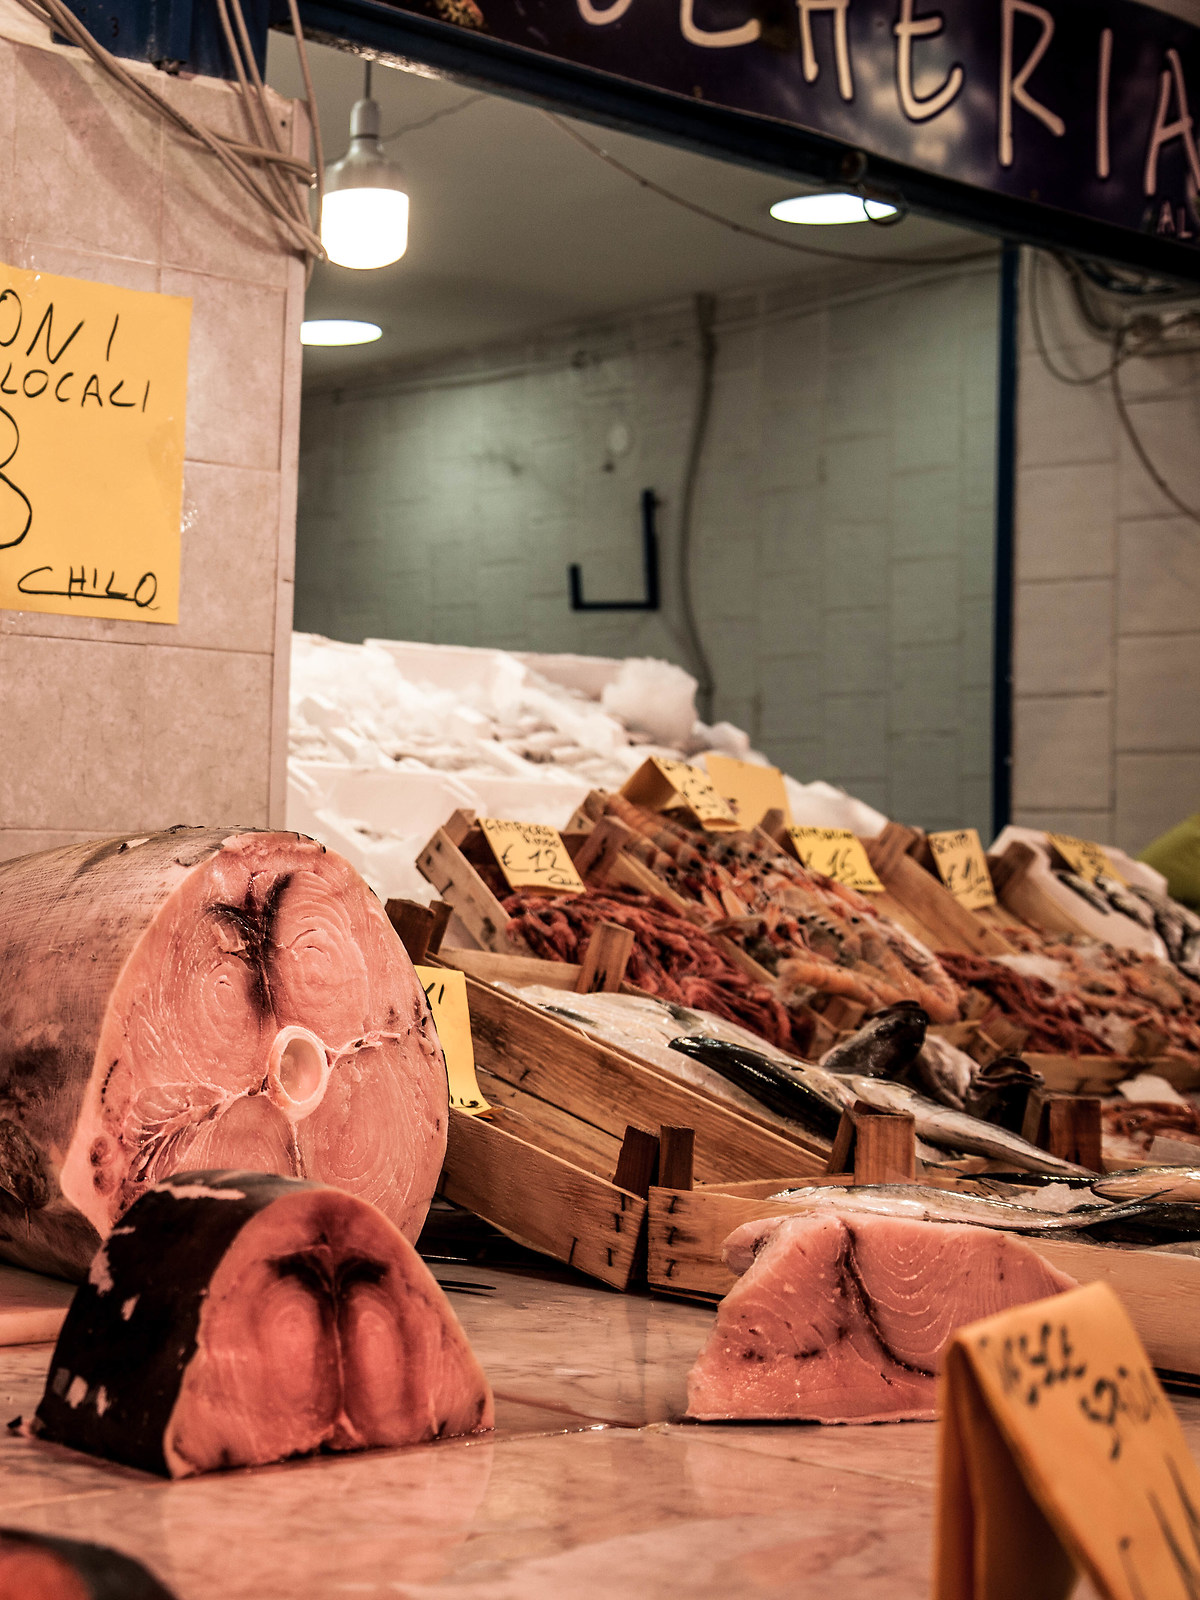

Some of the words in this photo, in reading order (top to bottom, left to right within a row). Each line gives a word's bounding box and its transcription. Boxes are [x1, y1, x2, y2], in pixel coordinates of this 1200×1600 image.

[0, 363, 150, 413] LOCALI
[17, 566, 160, 610] CHILO
[528, 849, 569, 873] 12
